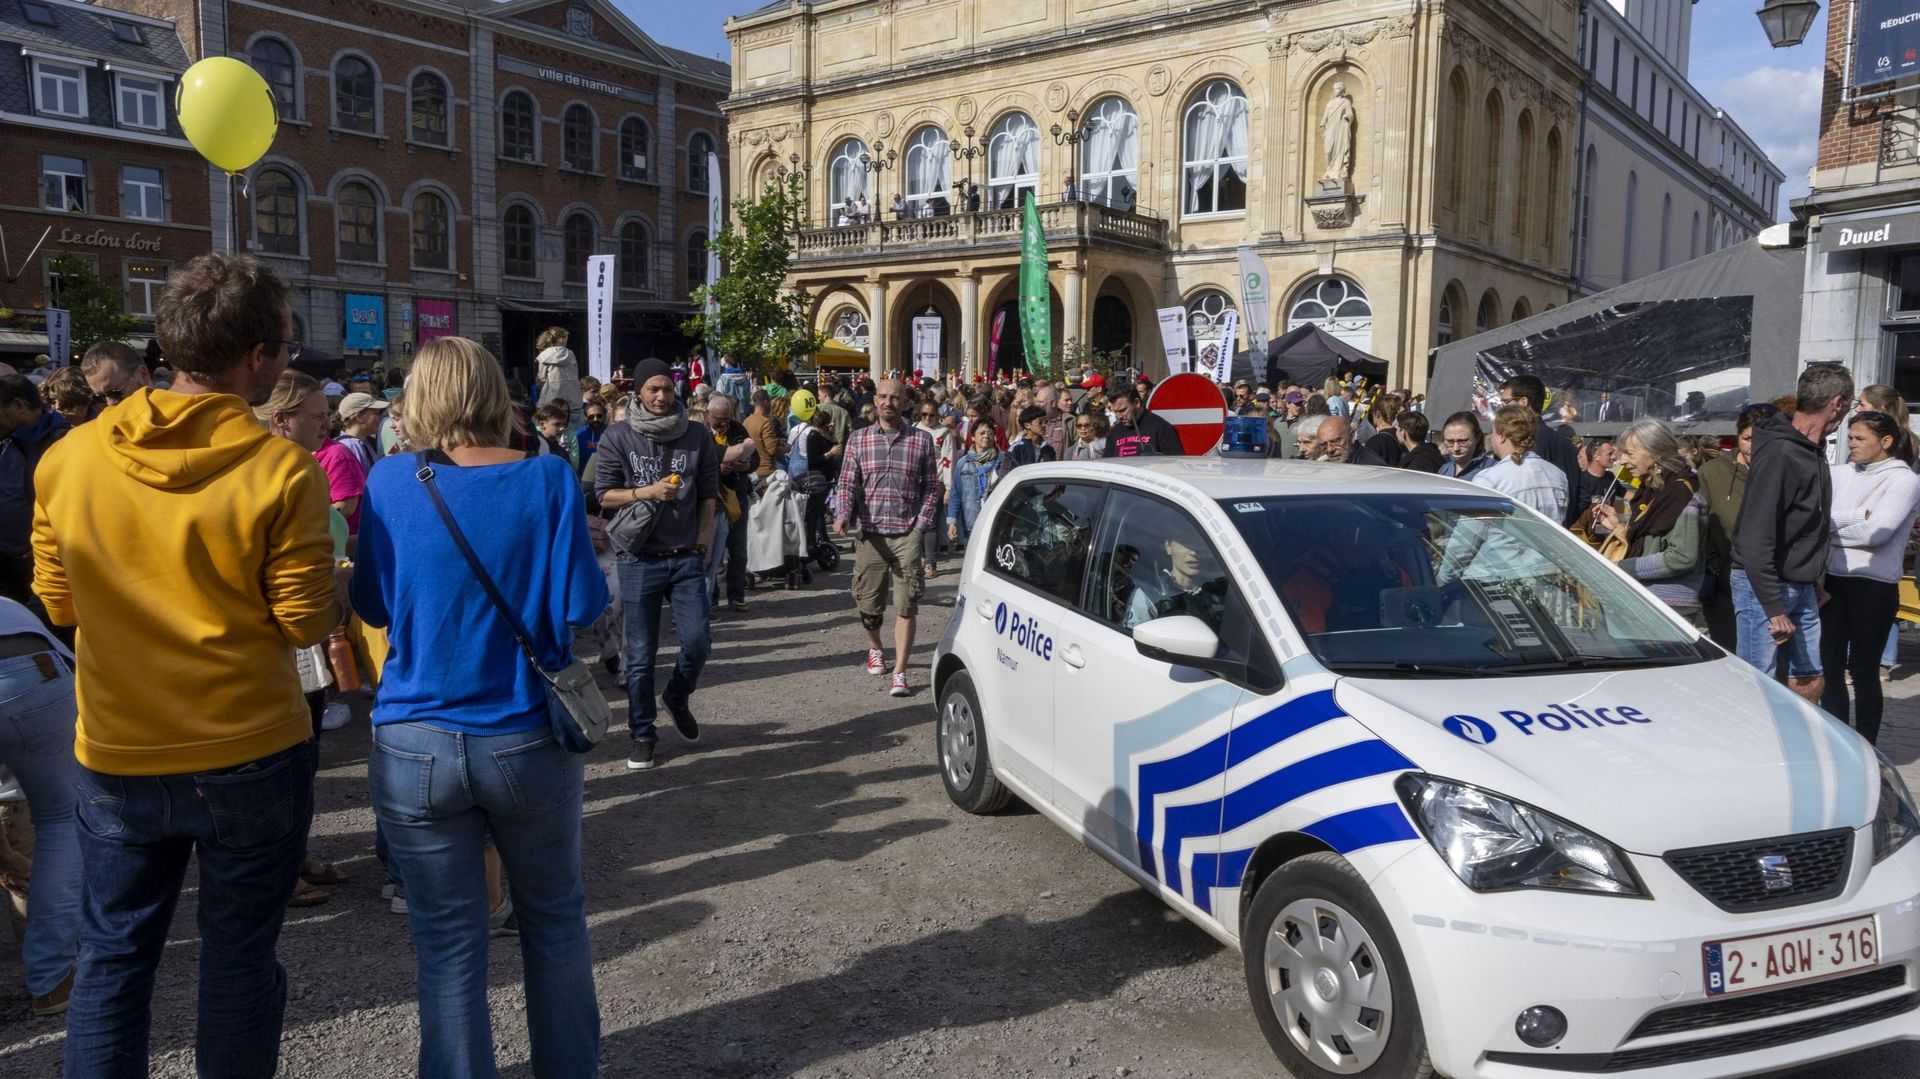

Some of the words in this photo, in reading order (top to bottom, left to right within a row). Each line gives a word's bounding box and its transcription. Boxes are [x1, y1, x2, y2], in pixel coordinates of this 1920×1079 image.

[565, 73, 579, 86] de
[581, 78, 622, 95] namur
[57, 228, 84, 244] Le
[85, 228, 120, 248] clou
[125, 231, 162, 251] doré
[1839, 223, 1891, 246] Duvel
[1009, 611, 1053, 661] Police
[996, 647, 1019, 672] Namur
[1498, 703, 1653, 736] Police
[1727, 927, 1874, 986] 2-AQW-316
[1709, 971, 1722, 988] B
